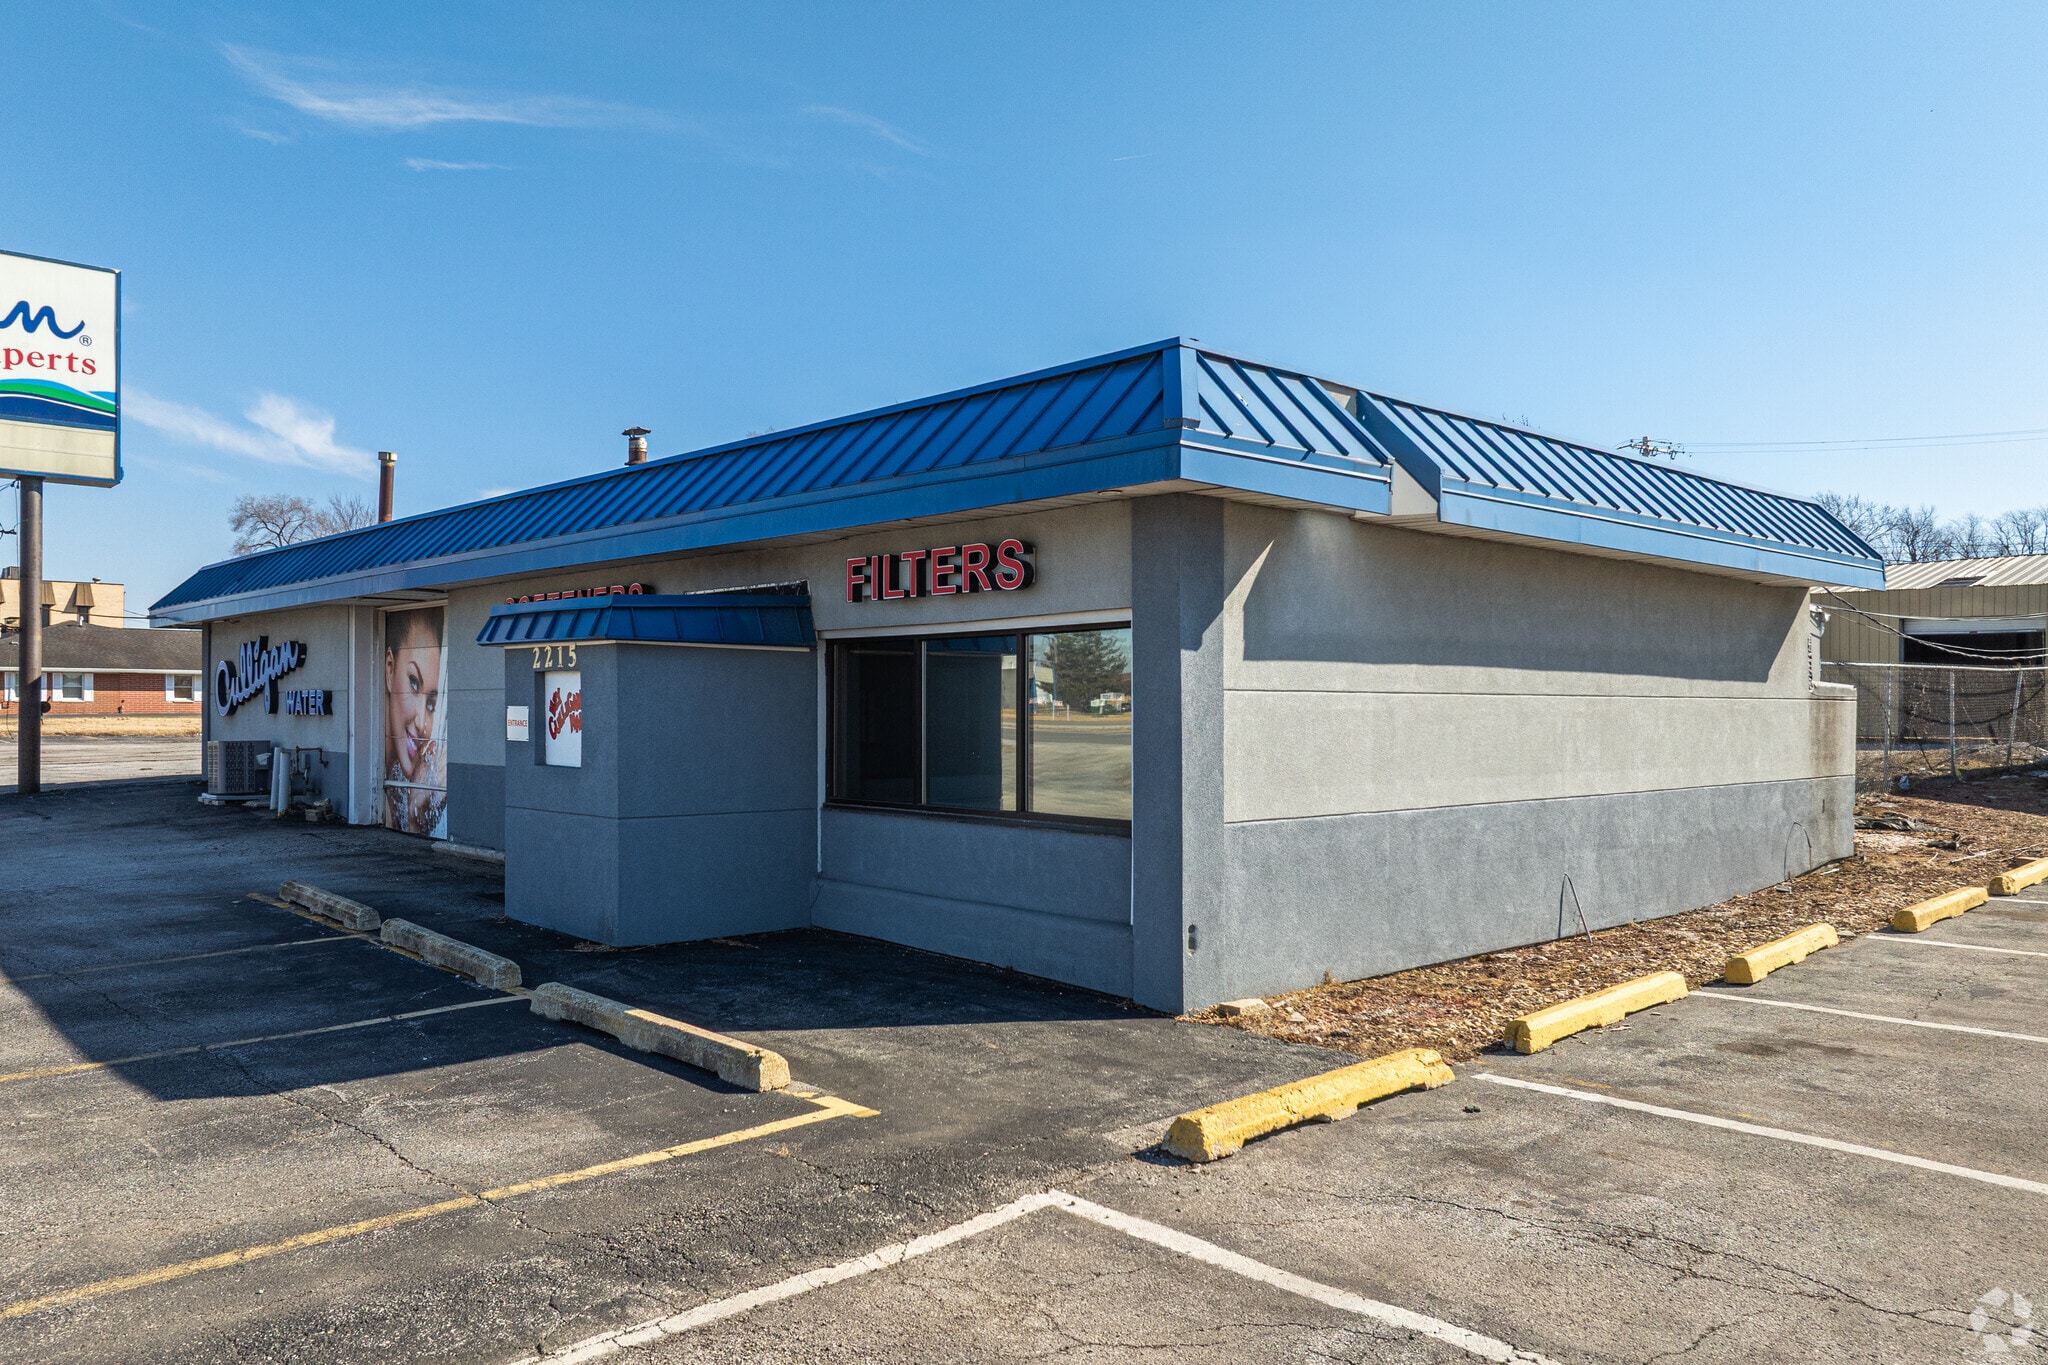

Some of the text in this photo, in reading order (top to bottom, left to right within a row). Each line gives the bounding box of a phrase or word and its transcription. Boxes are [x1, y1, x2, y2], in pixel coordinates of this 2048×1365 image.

[0, 347, 97, 375] perts
[846, 538, 1026, 603] FILTERS
[532, 642, 577, 669] 2215
[214, 635, 302, 717] Culligan
[285, 688, 326, 716] WATER
